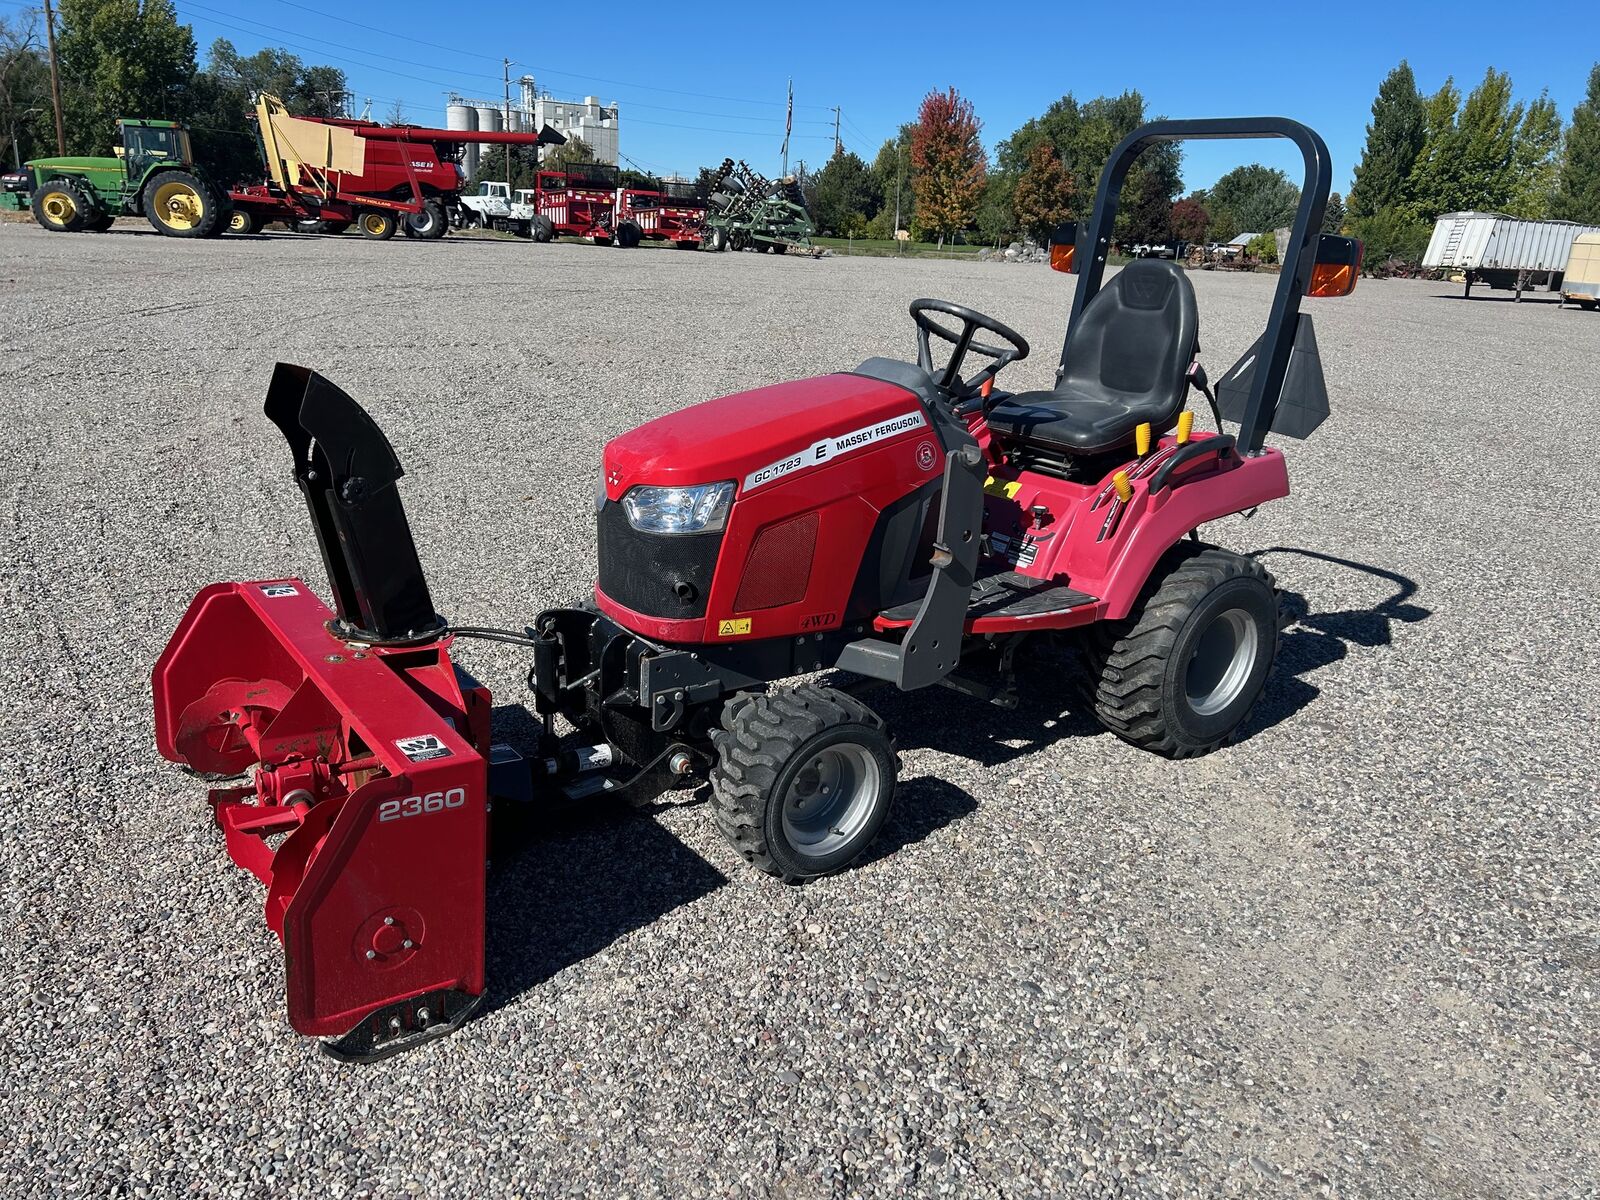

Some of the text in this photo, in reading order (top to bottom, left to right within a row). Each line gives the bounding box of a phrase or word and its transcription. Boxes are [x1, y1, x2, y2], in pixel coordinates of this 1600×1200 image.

[367, 199, 391, 207] HOLLAND
[836, 416, 919, 450] MASSEY FERGUSON
[815, 444, 827, 460] E
[754, 457, 801, 484] GC 1723
[801, 613, 836, 628] 4WD
[380, 788, 465, 821] 2360
